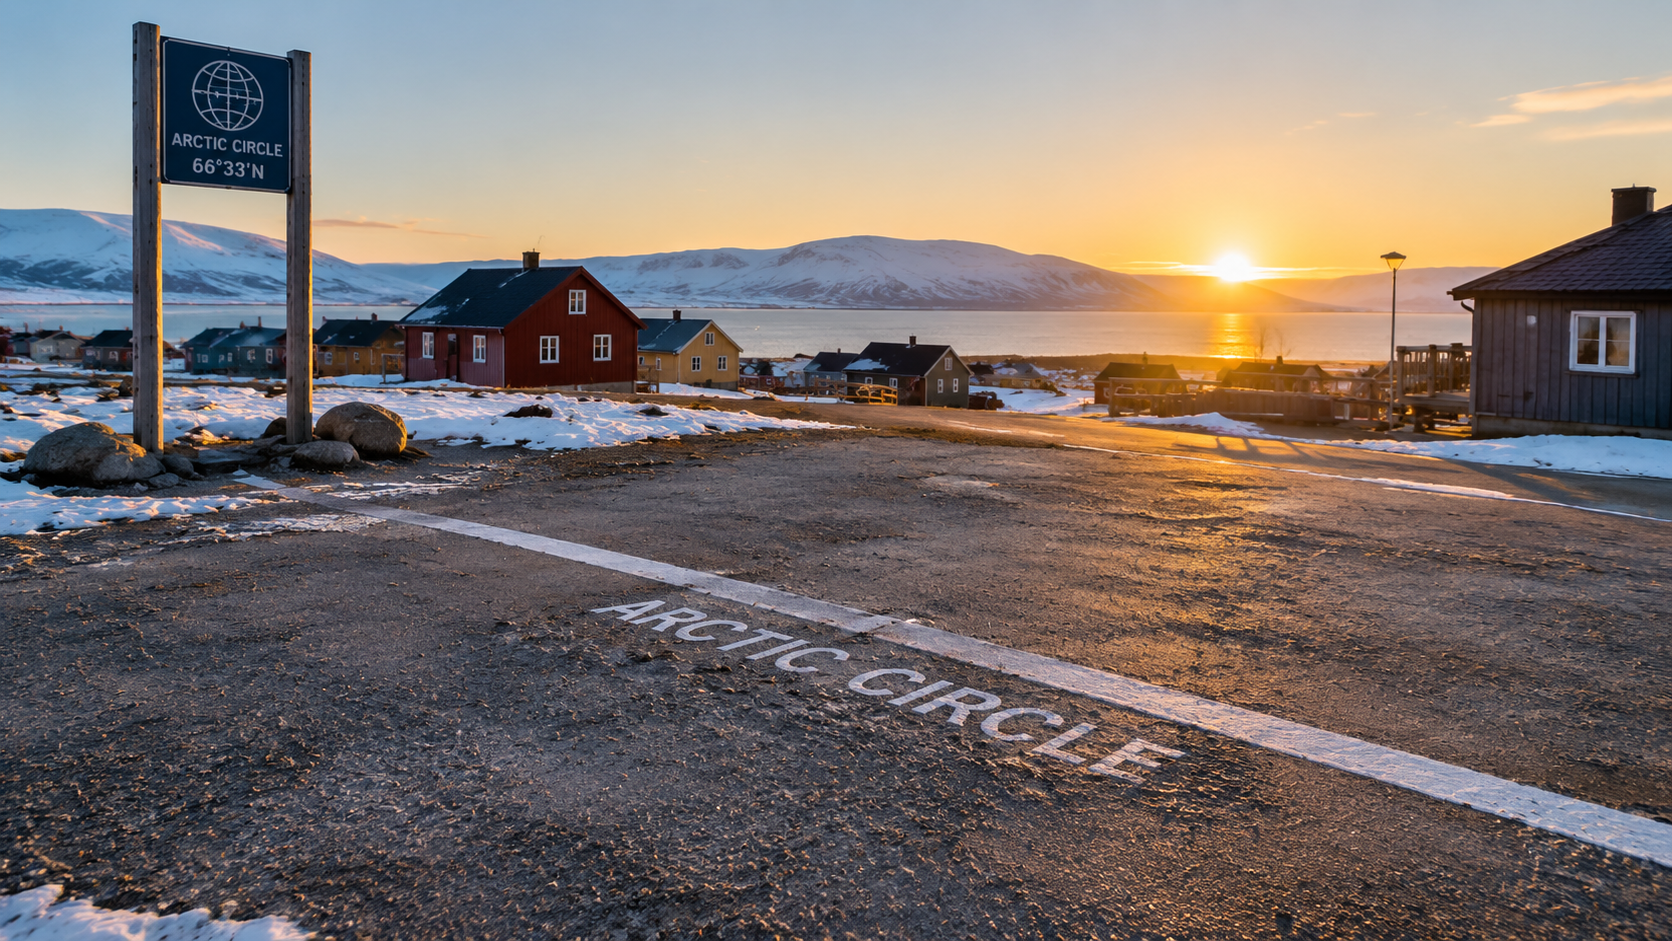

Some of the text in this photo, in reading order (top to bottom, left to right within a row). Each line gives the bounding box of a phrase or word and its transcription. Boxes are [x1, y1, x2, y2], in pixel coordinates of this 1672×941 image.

[172, 133, 283, 157] ARCTIC CIRCLE
[192, 157, 264, 179] 66°33'N
[592, 600, 1187, 784] ARCTIC CIRCLE
